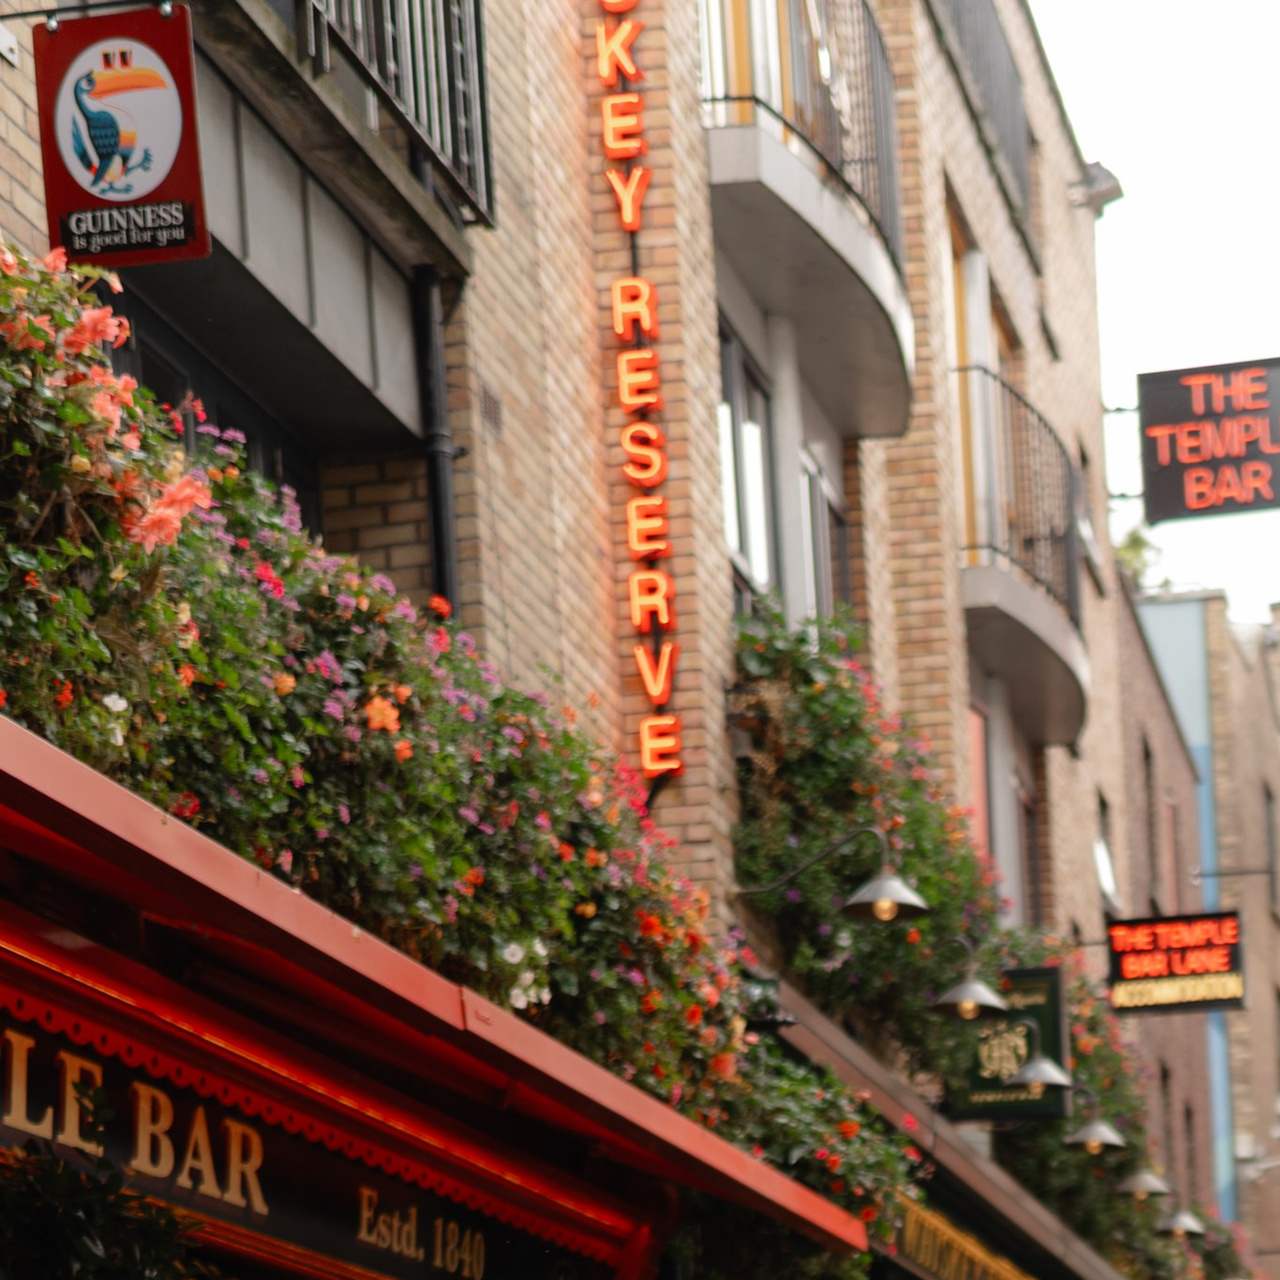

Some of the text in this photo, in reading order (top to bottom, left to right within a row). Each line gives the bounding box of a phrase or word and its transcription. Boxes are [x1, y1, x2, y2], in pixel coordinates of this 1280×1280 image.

[69, 202, 184, 235] GUINNESS
[73, 226, 185, 253] is good for you
[597, 0, 684, 778] KEY RESERVE
[1179, 367, 1271, 416] THE
[1183, 460, 1275, 510] BAR
[1109, 917, 1239, 953] THE TEMPLE
[1121, 951, 1169, 980] BAR
[130, 1080, 269, 1216] BAR
[357, 1184, 424, 1263] Estd.
